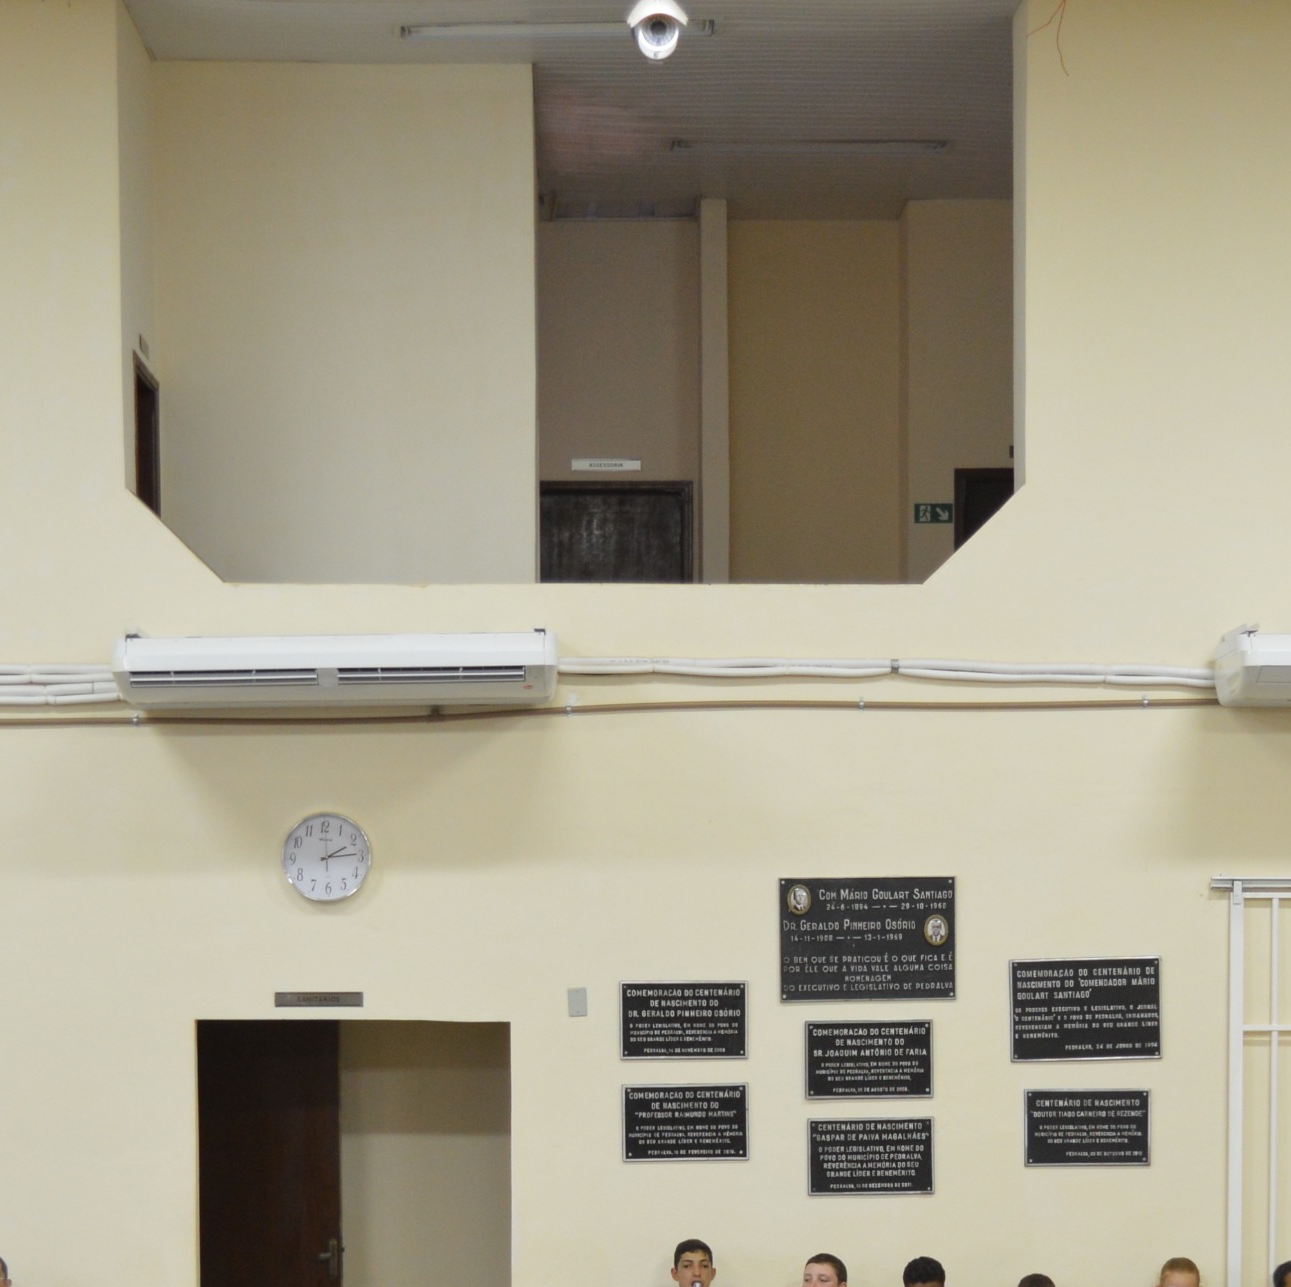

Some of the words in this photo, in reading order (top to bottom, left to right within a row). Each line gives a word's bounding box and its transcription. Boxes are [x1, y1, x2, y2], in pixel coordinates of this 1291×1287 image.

[306, 825, 312, 837] 11
[321, 820, 330, 833] 12
[339, 824, 342, 836] 1
[294, 836, 302, 849] 10
[351, 833, 357, 846] 2
[290, 852, 296, 865] 9
[358, 849, 364, 862] 3
[297, 868, 303, 881] 8
[352, 866, 358, 879] 4
[311, 879, 316, 891] 7
[326, 882, 332, 894] 6
[341, 878, 347, 890] 5
[884, 953, 888, 962] É
[949, 952, 953, 961] É
[1093, 966, 1141, 976] CENTENÁRIO
[1146, 967, 1155, 975] DE
[1017, 980, 1060, 989] NASCIMENTO
[695, 987, 740, 996] CENTENÁRIO
[1017, 992, 1048, 1000] GOULART
[714, 1008, 741, 1017] OSÓRIO
[881, 1026, 925, 1035] CENTENÁRIO
[697, 1089, 740, 1098] CENTENÁRIO
[1036, 1098, 1080, 1107] CENTENÁRIO
[818, 1123, 863, 1131] CENTENÁRIO
